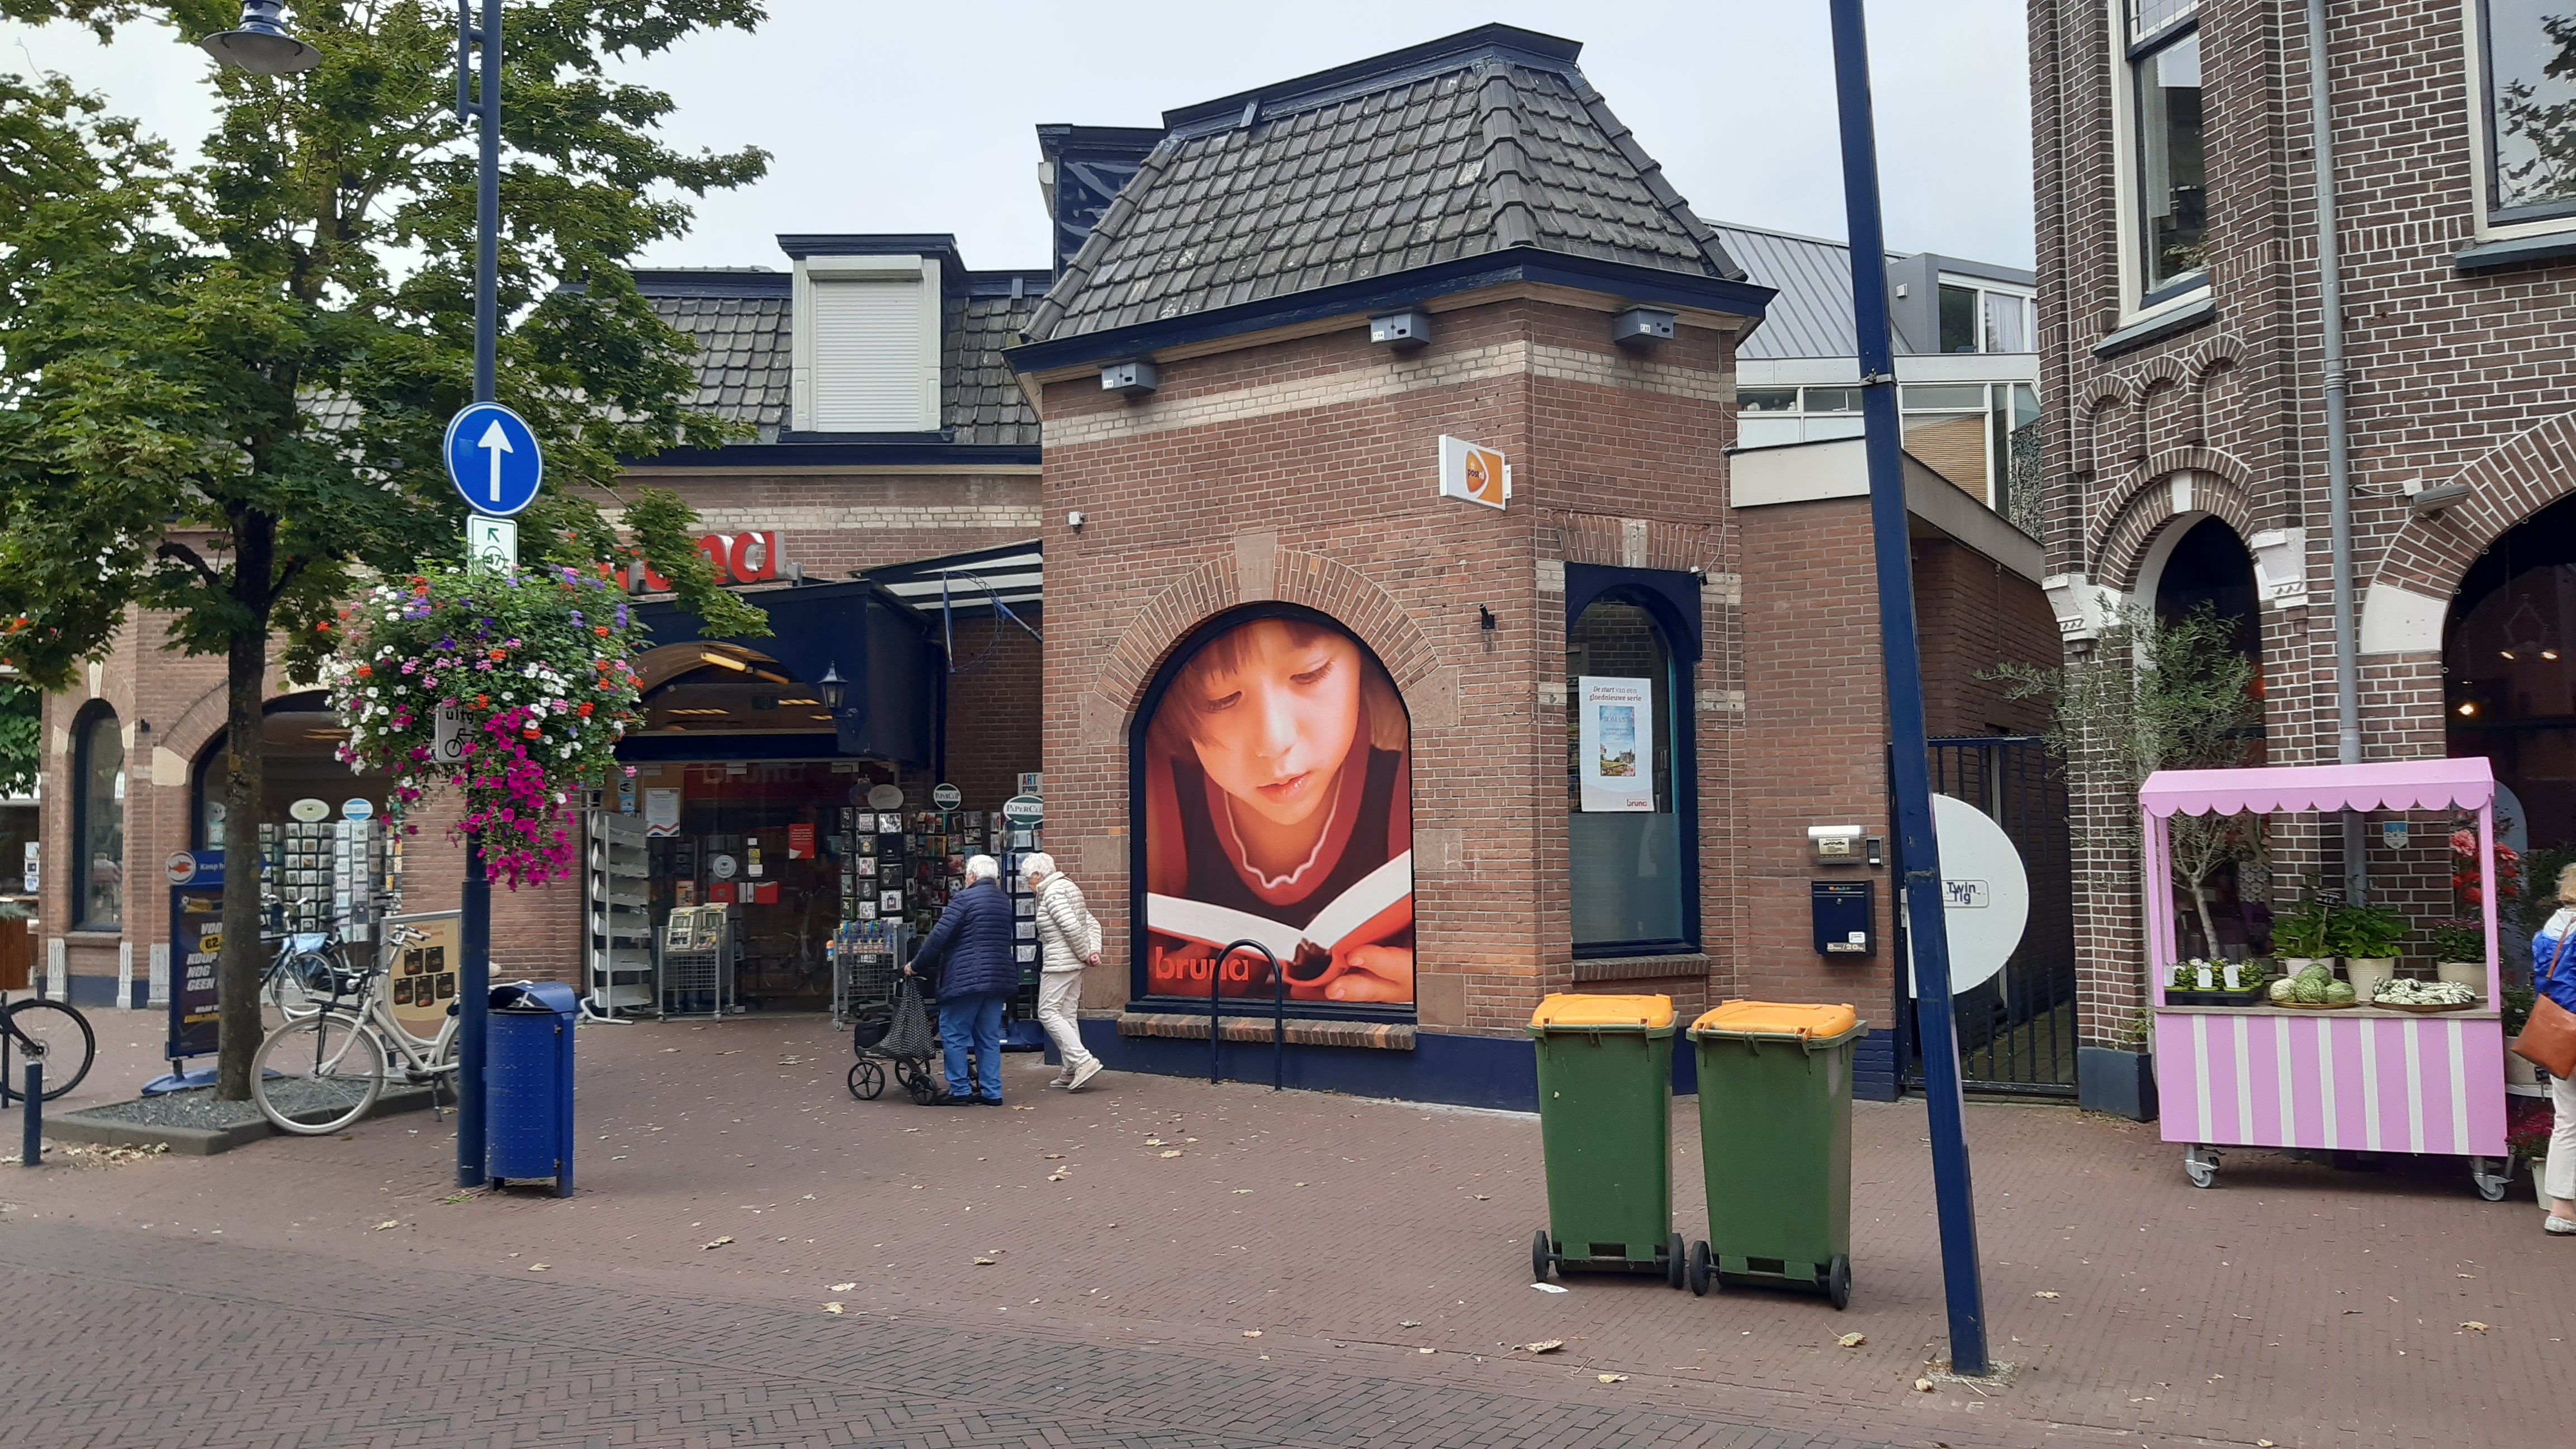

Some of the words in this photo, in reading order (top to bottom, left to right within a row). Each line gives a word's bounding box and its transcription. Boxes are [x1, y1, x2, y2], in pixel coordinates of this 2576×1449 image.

[1022, 774, 1038, 785] ART
[1006, 804, 1043, 813] PAPERCLI
[1946, 882, 1976, 894] Twin
[201, 922, 223, 934] VOO
[186, 951, 218, 965] KOOP
[1156, 946, 1249, 981] bruna
[186, 965, 211, 978] NOG
[187, 978, 215, 992] GEEN
